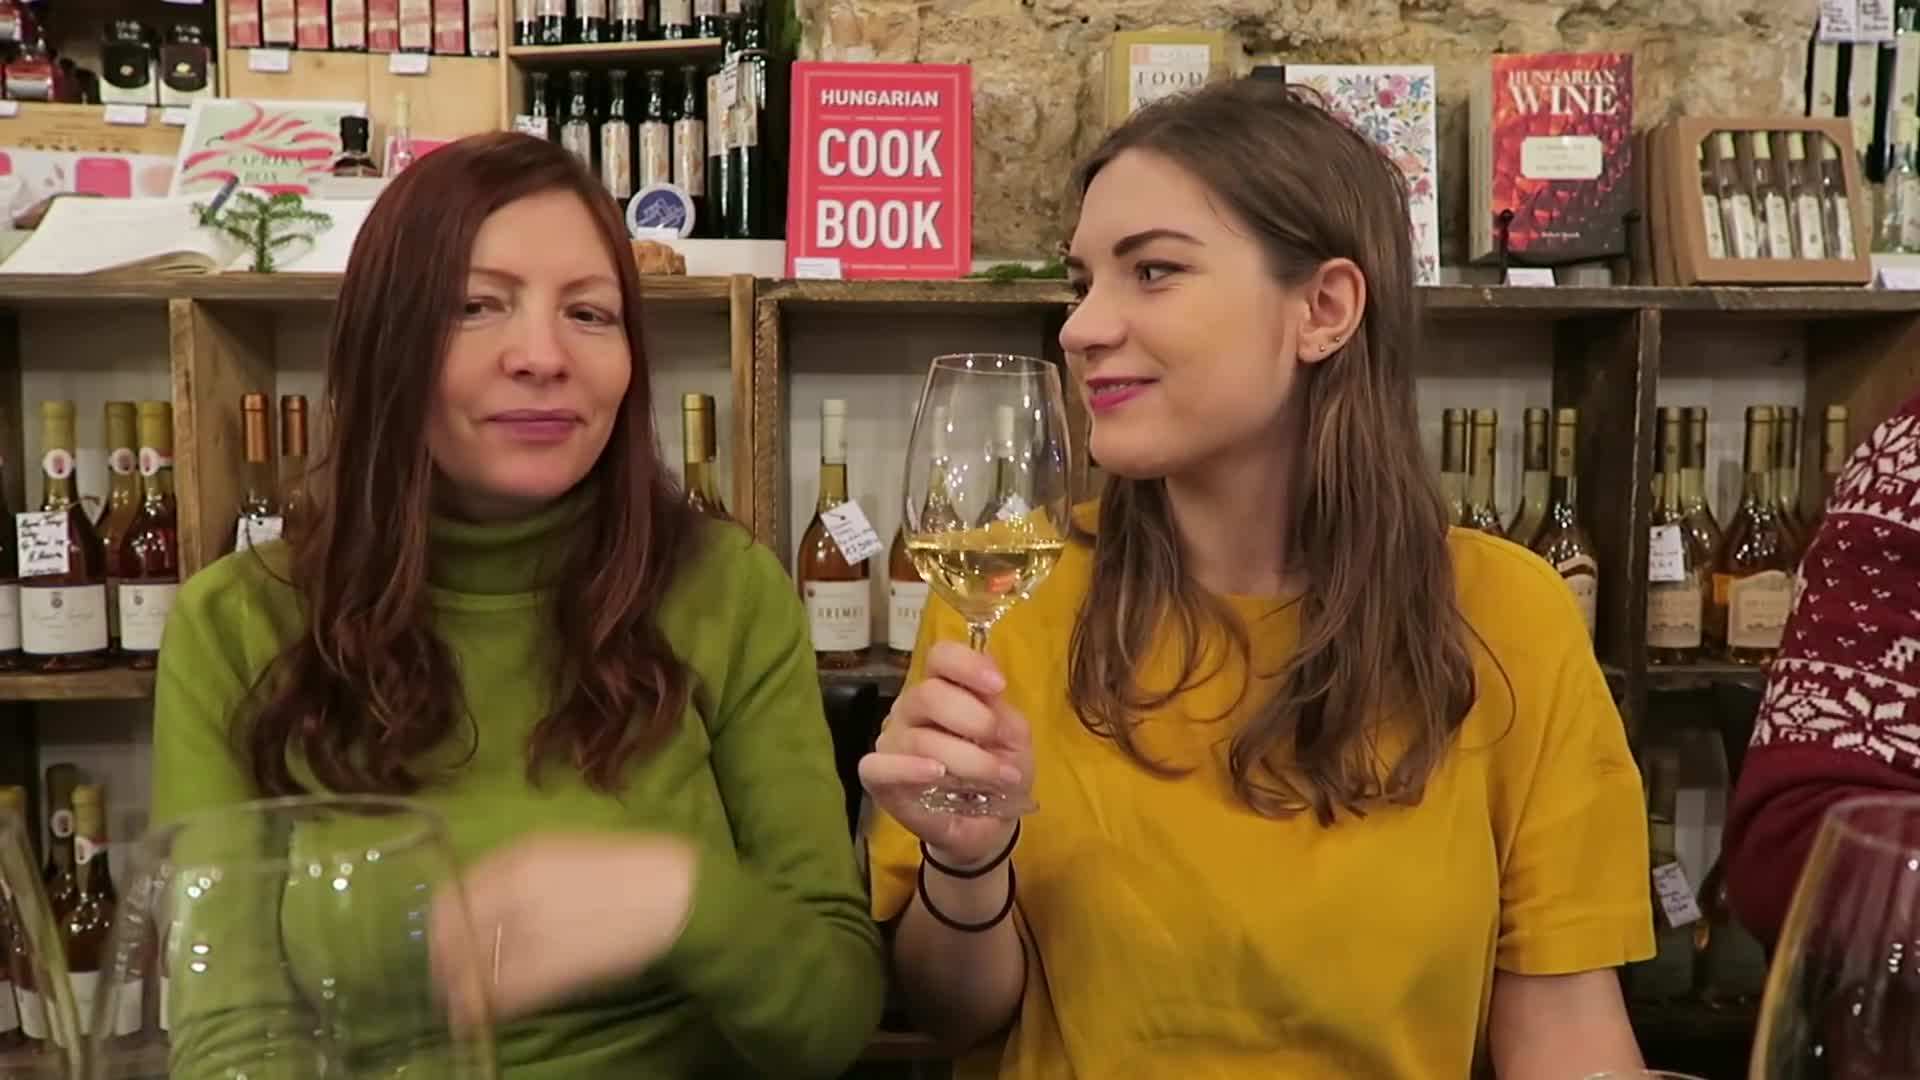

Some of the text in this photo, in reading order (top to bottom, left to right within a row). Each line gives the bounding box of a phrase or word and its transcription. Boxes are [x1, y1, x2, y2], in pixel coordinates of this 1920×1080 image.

[1137, 71, 1203, 86] FOOD
[1508, 69, 1616, 84] HUNGARIAN
[820, 88, 939, 106] HUNGARIAN
[1509, 84, 1617, 115] WINE
[227, 154, 305, 168] PAPRIKA
[818, 127, 943, 177] COOK
[816, 199, 943, 249] BOOK
